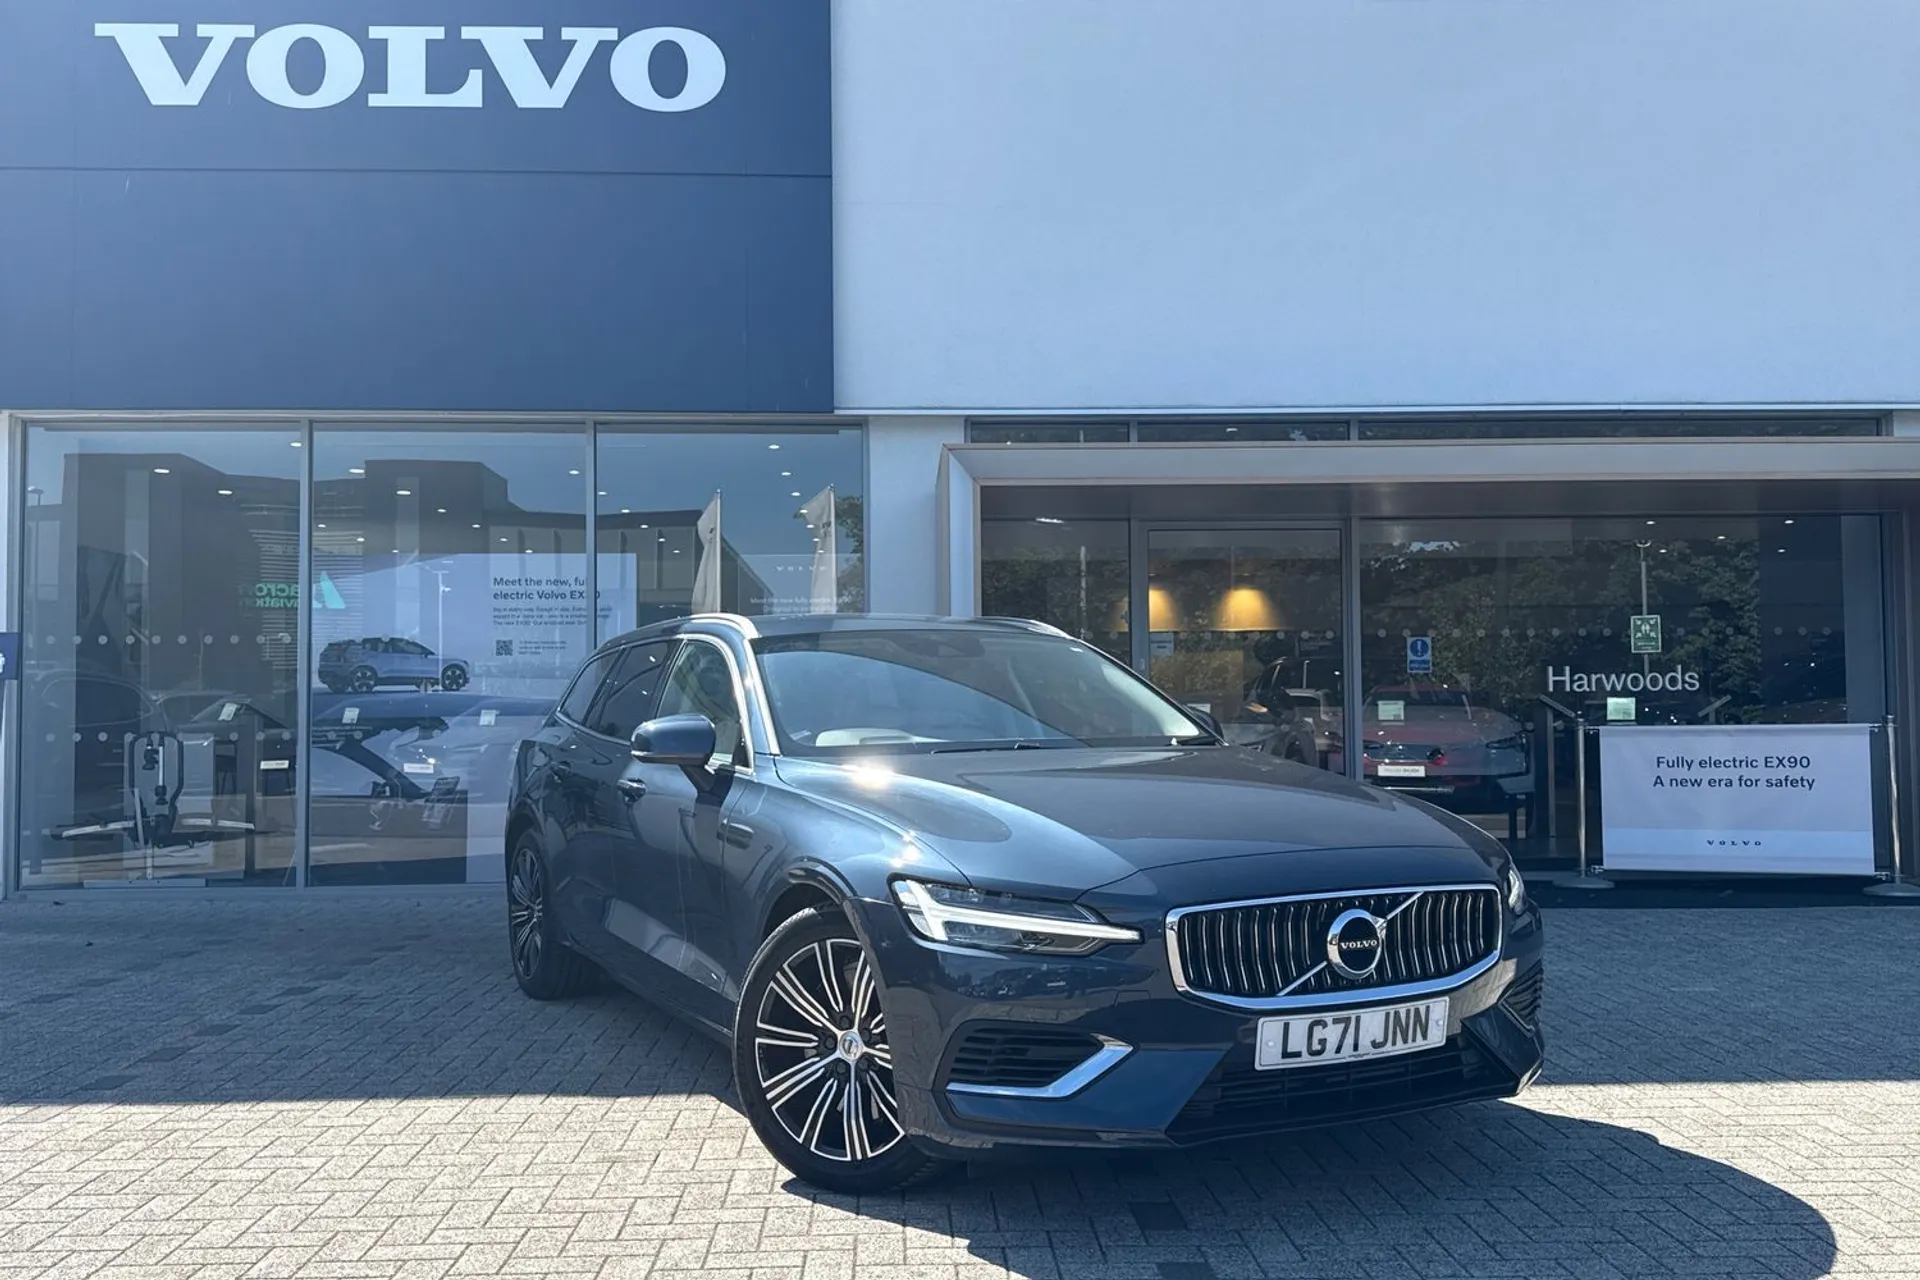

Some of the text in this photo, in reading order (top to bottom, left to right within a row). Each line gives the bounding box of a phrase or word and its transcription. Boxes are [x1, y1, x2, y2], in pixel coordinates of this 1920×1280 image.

[95, 23, 727, 112] VOLVO
[493, 577, 522, 586] Meet
[525, 577, 543, 586] the
[546, 578, 571, 588] new,
[493, 590, 534, 600] electric
[537, 590, 567, 600] Volvo
[1548, 664, 1700, 692] Harwoods
[1656, 755, 1811, 771] Fully electric EX90
[1653, 775, 1816, 791] A new era for safety
[1340, 938, 1378, 949] VOLVO
[1281, 1005, 1430, 1060] LG71 JNN
